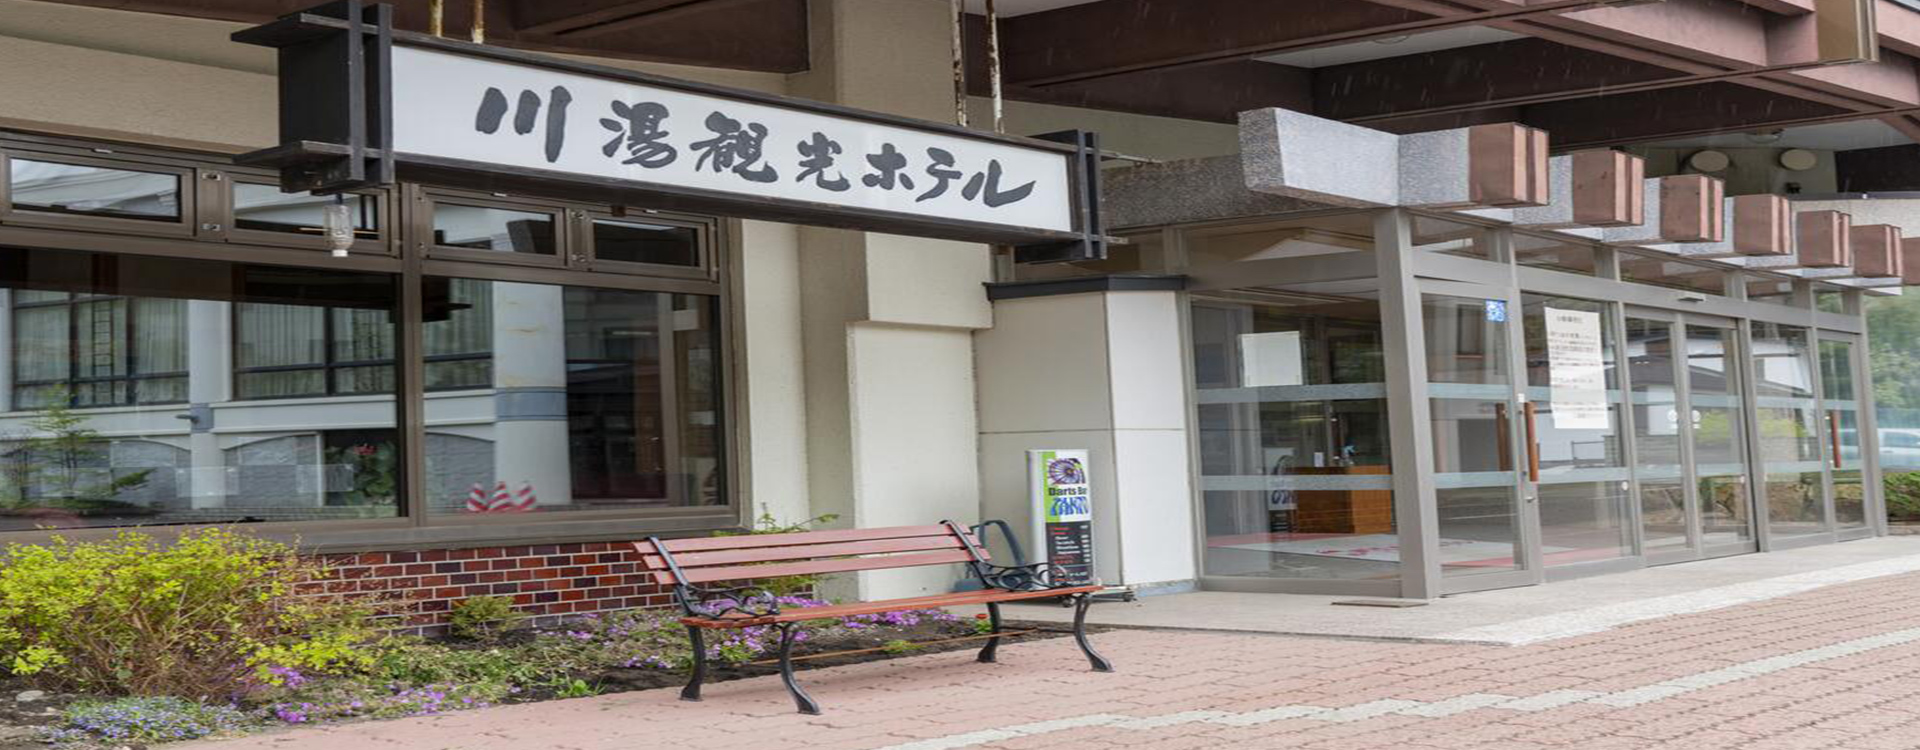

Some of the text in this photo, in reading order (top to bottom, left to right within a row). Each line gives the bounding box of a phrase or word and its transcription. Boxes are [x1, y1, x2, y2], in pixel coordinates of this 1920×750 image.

[475, 86, 1036, 208] 川湯観光ホテル
[1048, 487, 1077, 496] Darts
